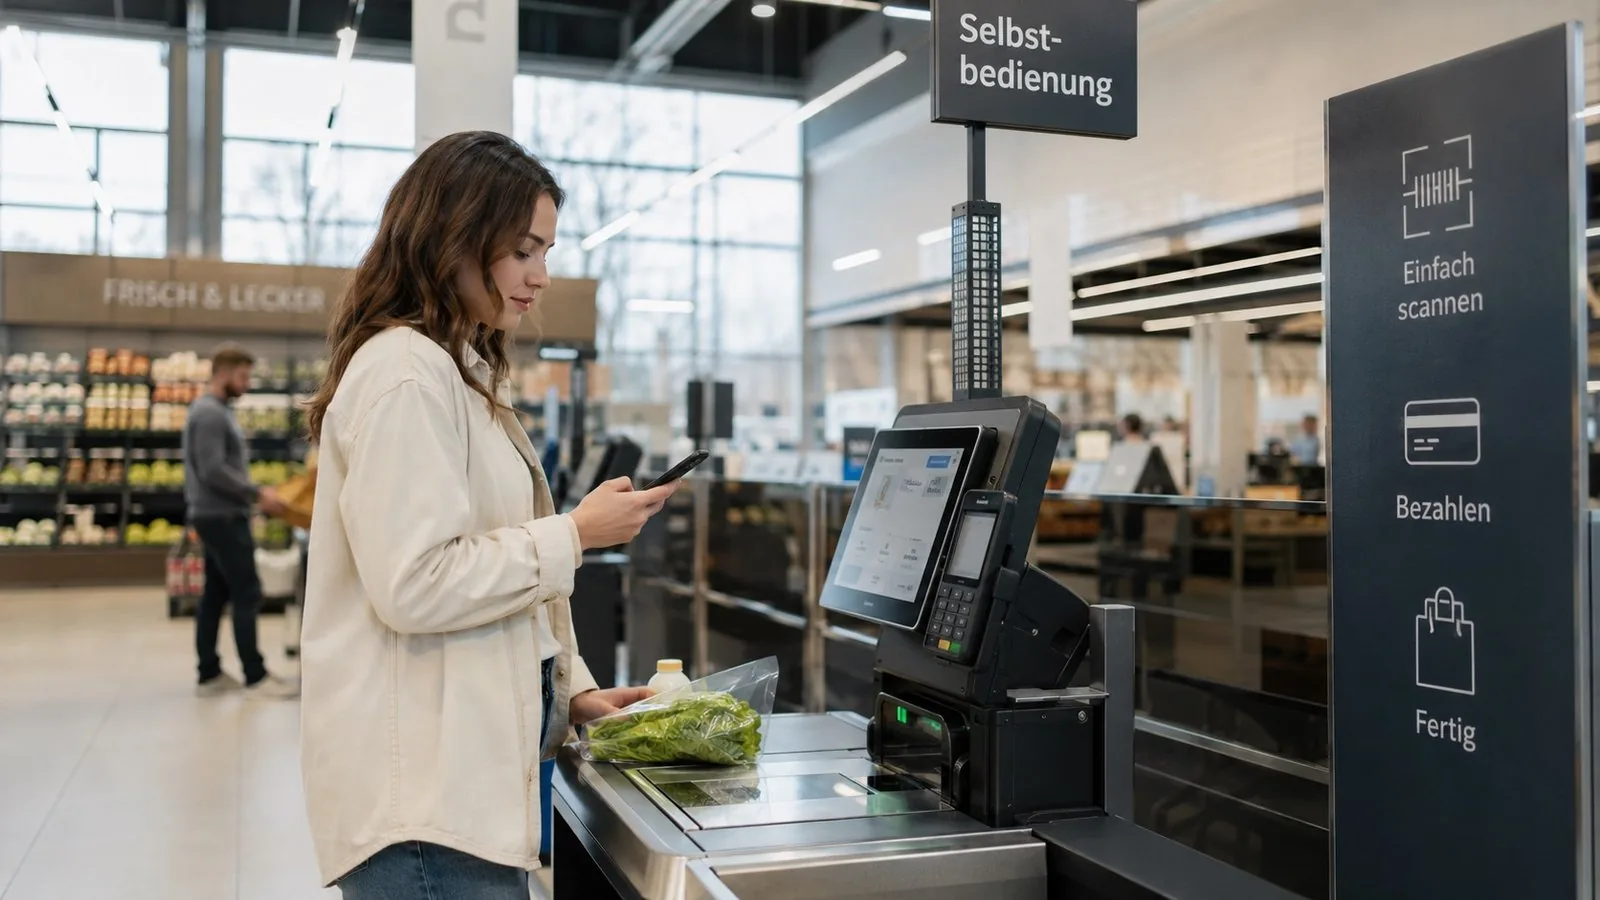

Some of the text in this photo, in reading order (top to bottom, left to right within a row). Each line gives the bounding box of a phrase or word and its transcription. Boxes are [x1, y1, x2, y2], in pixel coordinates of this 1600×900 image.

[959, 13, 1062, 51] Selbst-
[960, 54, 1112, 106] bedienung
[1404, 251, 1475, 284] Einfach
[103, 278, 326, 313] FRISCH & LECKER
[1398, 292, 1483, 320] scannen
[1396, 495, 1491, 522] Bezahlen
[1416, 709, 1476, 752] Fertig
